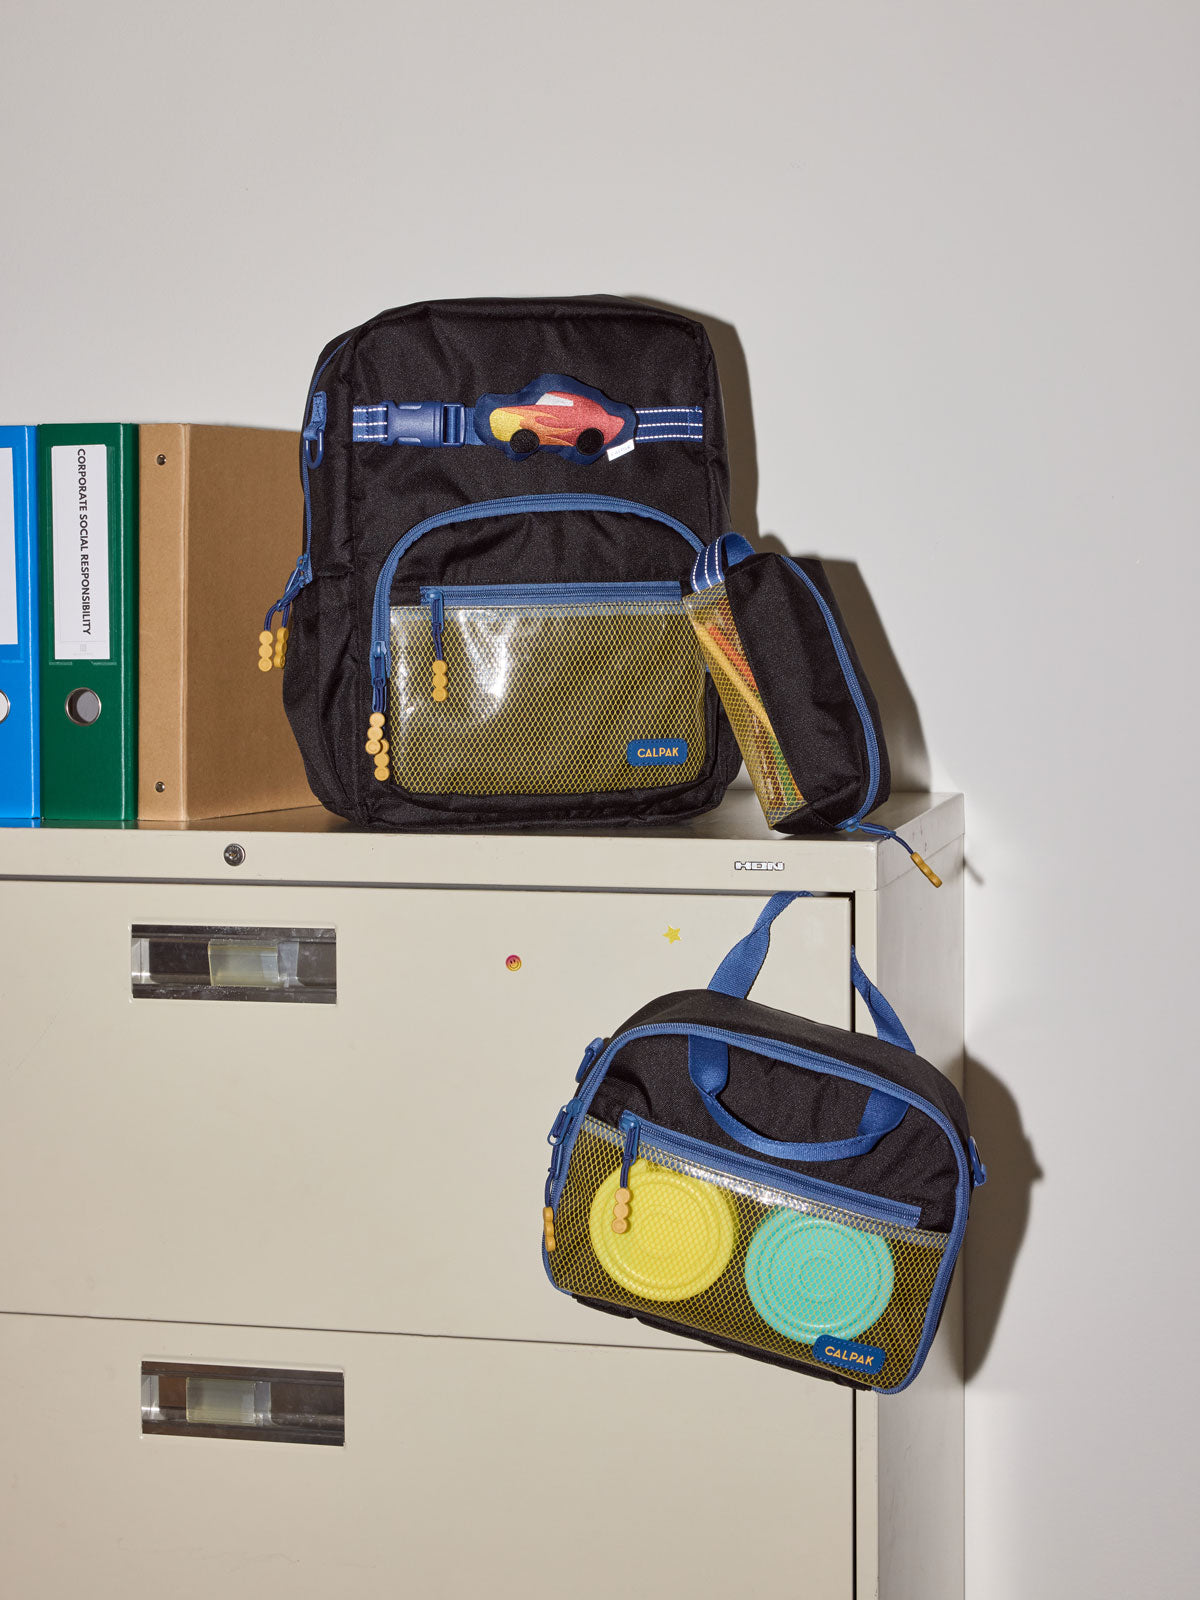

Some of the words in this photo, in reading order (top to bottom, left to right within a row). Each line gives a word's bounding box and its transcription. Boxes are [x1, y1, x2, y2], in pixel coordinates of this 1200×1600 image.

[77, 448, 88, 512] CORPORATE
[79, 513, 89, 552] SOCIAL
[80, 553, 92, 635] RESPONSIBILITY
[637, 747, 679, 758] CALPAK
[734, 861, 785, 871] HON
[824, 1346, 875, 1367] CALPAK
